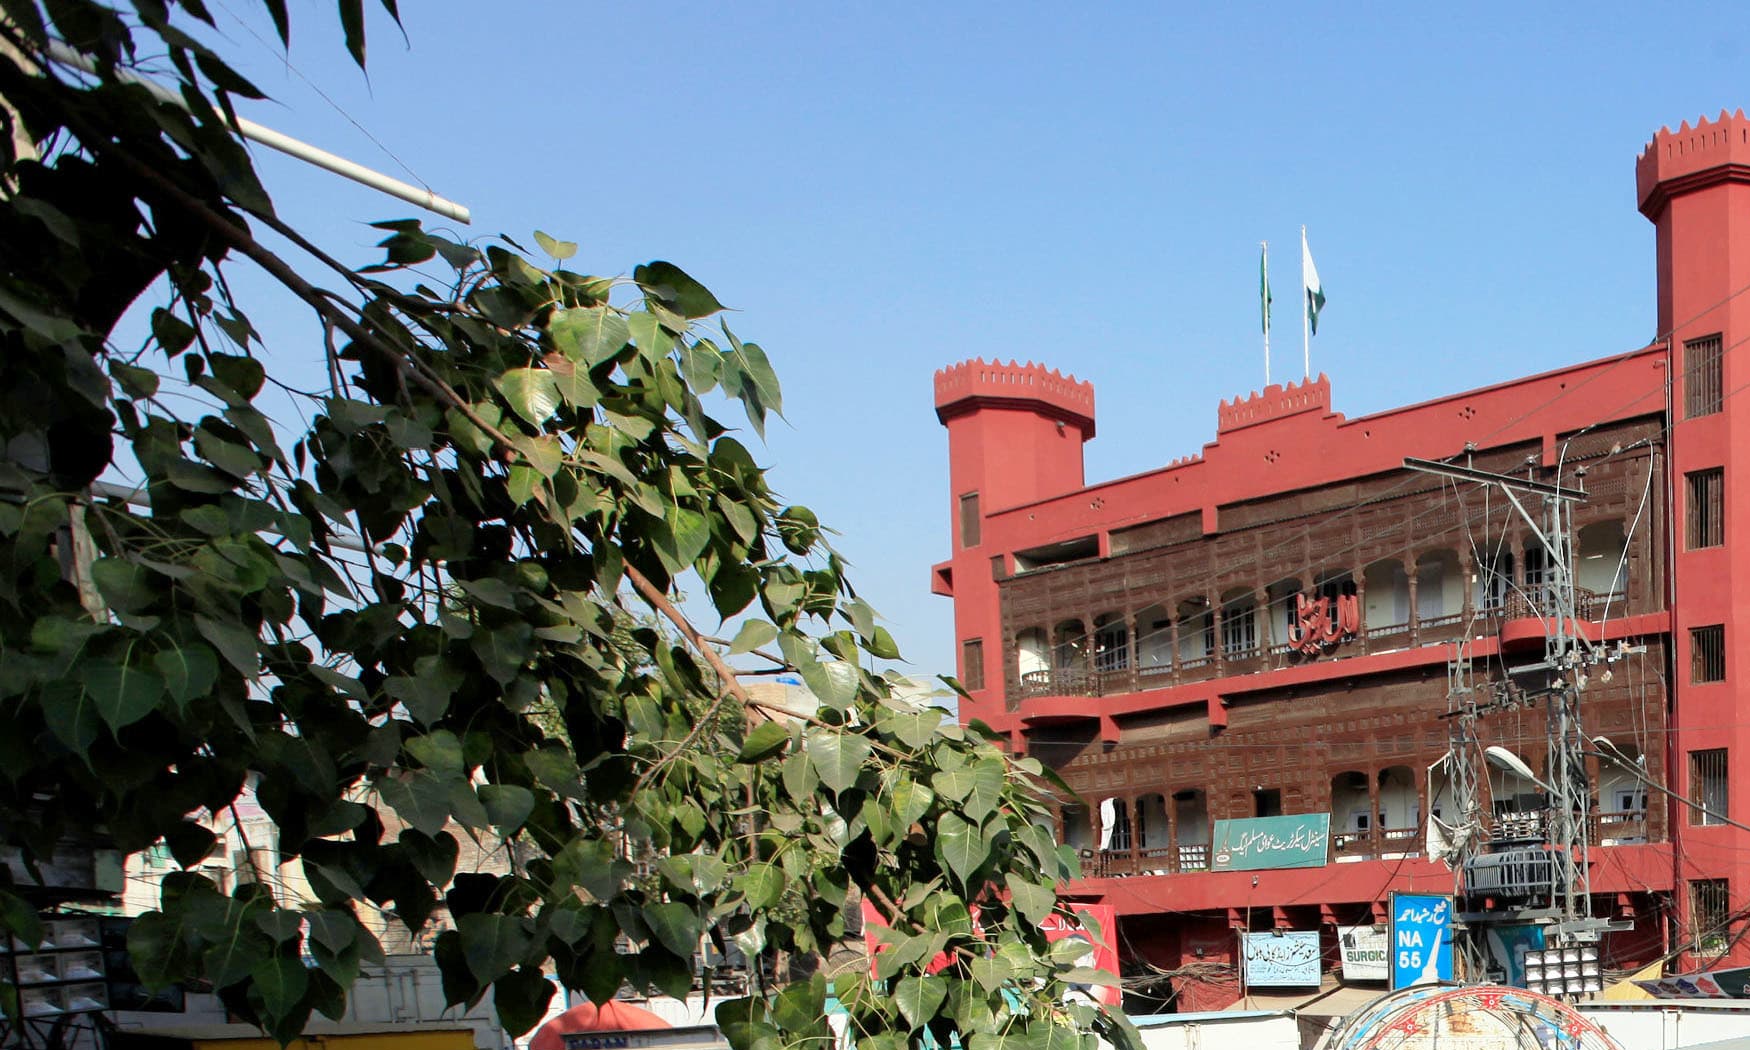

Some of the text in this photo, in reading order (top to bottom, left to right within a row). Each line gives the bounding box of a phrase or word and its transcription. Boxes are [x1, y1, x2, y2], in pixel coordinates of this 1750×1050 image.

[1398, 930, 1423, 948] NA
[1347, 950, 1388, 962] SURGIC
[1399, 951, 1422, 968] 55
